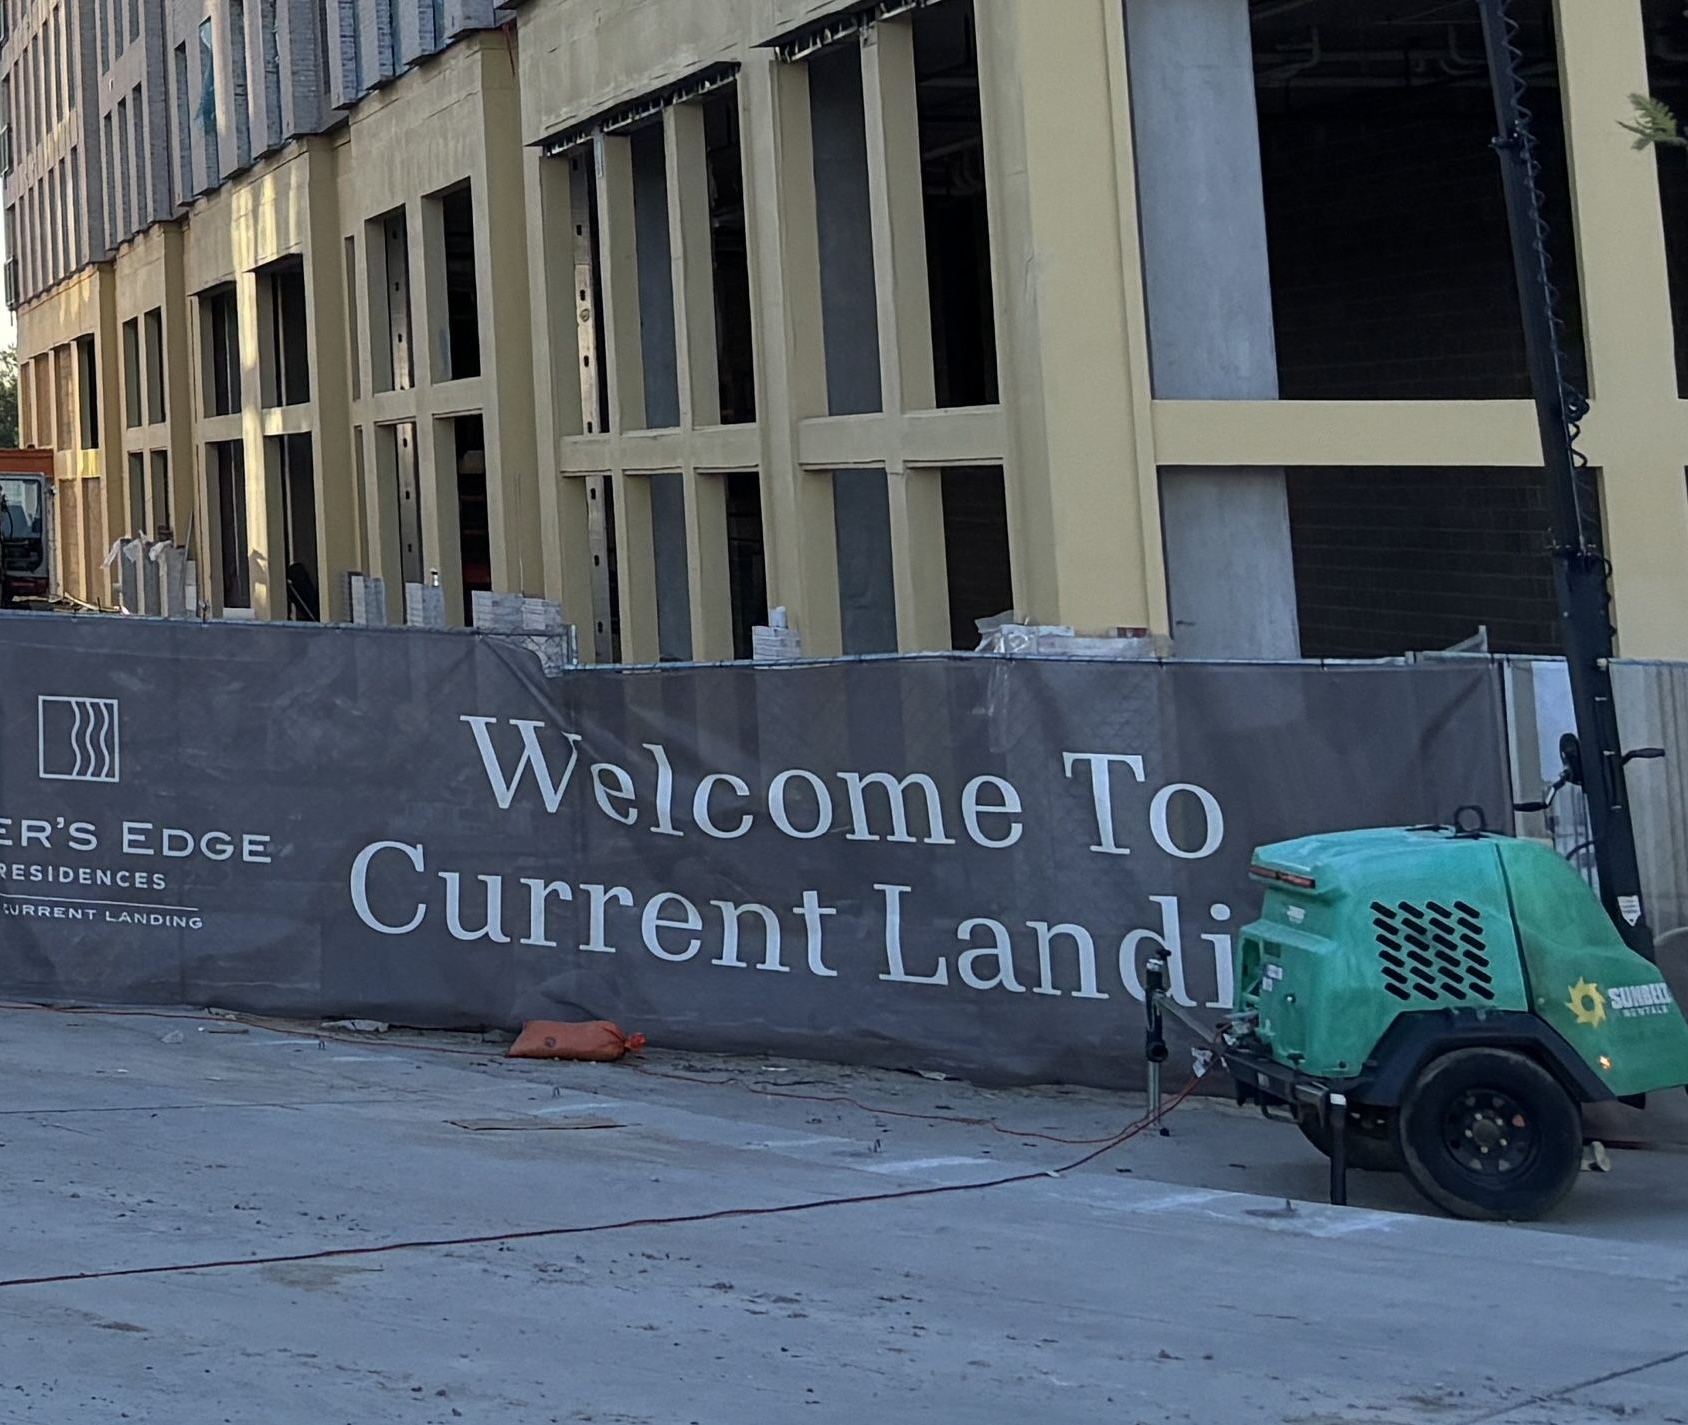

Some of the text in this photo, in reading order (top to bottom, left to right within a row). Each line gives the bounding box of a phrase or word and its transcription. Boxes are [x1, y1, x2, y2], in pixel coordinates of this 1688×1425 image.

[459, 713, 1226, 861] Welcome To
[122, 821, 274, 864] EDGE
[104, 910, 204, 930] LANDING
[347, 839, 839, 979] Current
